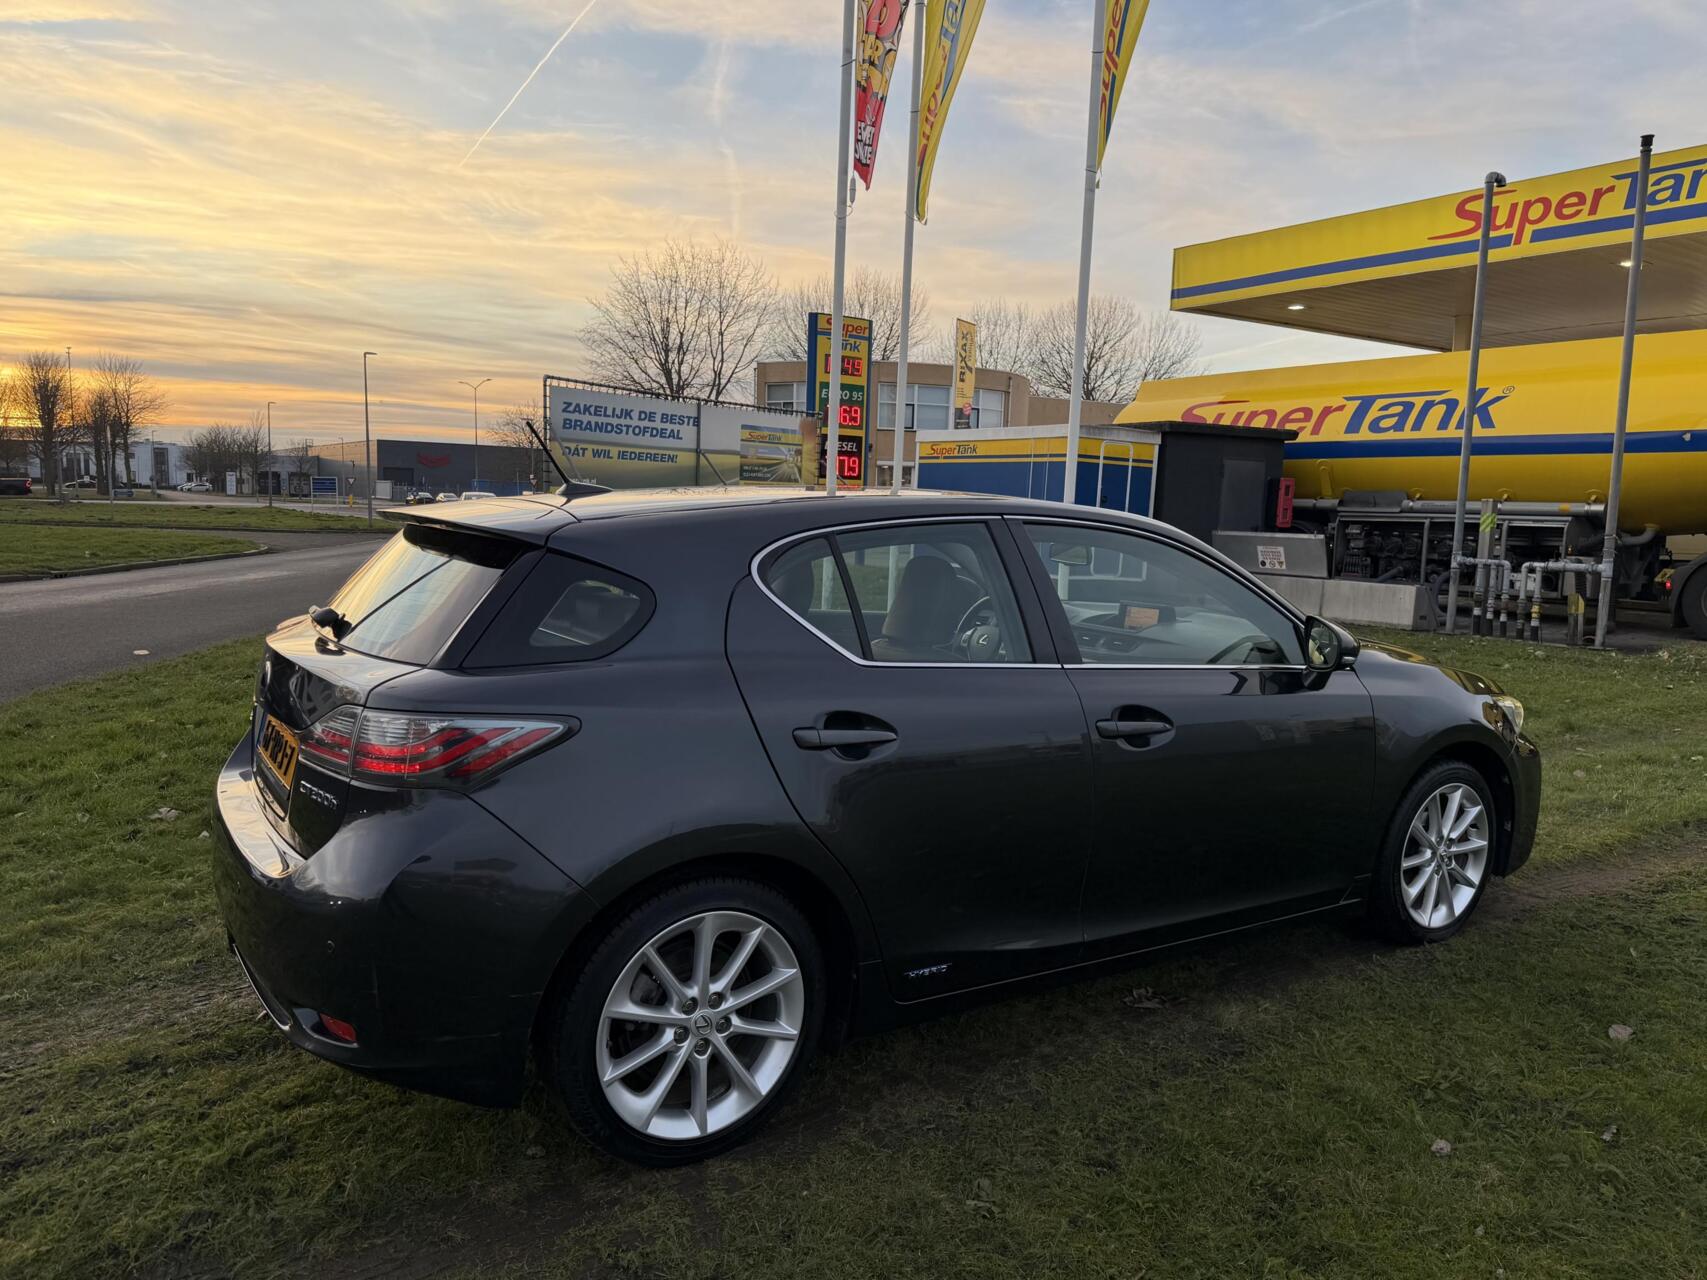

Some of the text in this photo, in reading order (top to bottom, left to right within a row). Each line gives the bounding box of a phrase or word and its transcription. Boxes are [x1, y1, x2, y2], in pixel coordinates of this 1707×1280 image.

[827, 337, 861, 352] nk
[821, 389, 863, 401] EO 95
[562, 401, 700, 428] ZAKELIJK DE BESTE
[562, 418, 683, 441] BRANDSTOFDEAL
[824, 441, 858, 452] ESEL
[926, 443, 978, 458] SuperTank
[591, 448, 613, 460] WIL
[616, 450, 679, 463] IEDEREEN!
